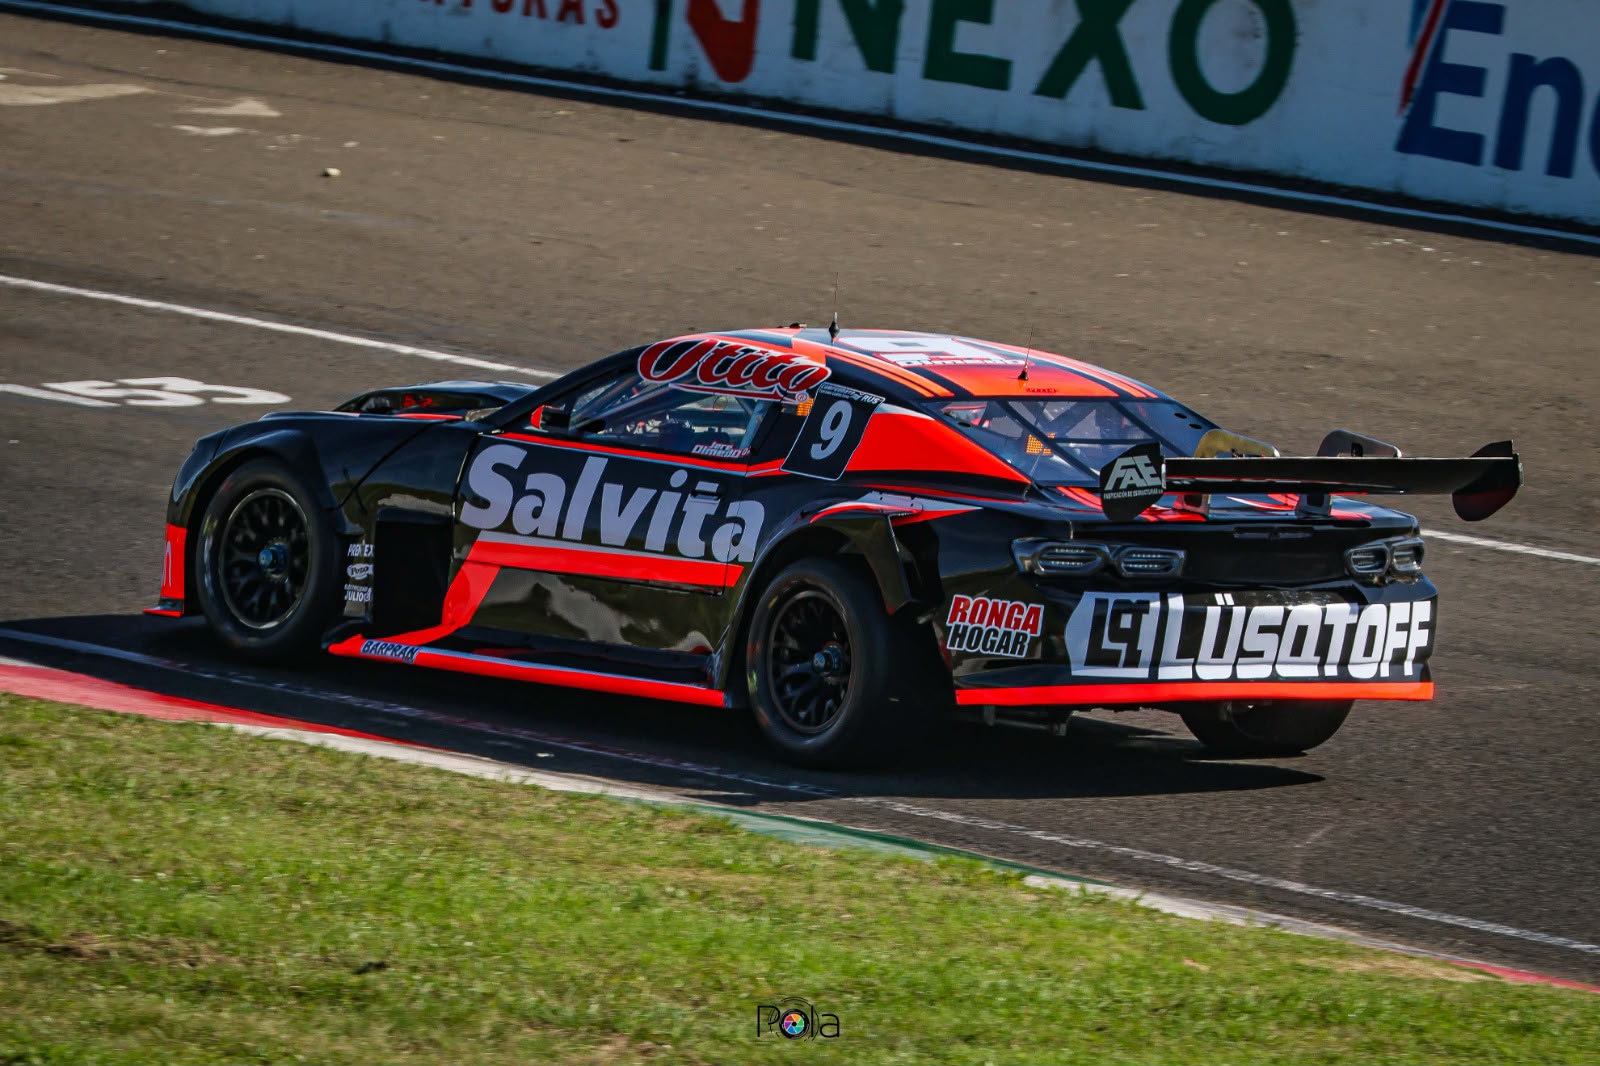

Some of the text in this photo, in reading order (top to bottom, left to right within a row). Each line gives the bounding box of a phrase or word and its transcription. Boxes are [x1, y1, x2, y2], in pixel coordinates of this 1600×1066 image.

[1394, 0, 1600, 179] En
[810, 399, 853, 461] 9
[1104, 454, 1162, 491] FAE
[459, 443, 766, 563] Salvita
[946, 594, 1045, 637] RONGA
[361, 640, 420, 662] BARPRAN
[946, 622, 1031, 658] HOGAR
